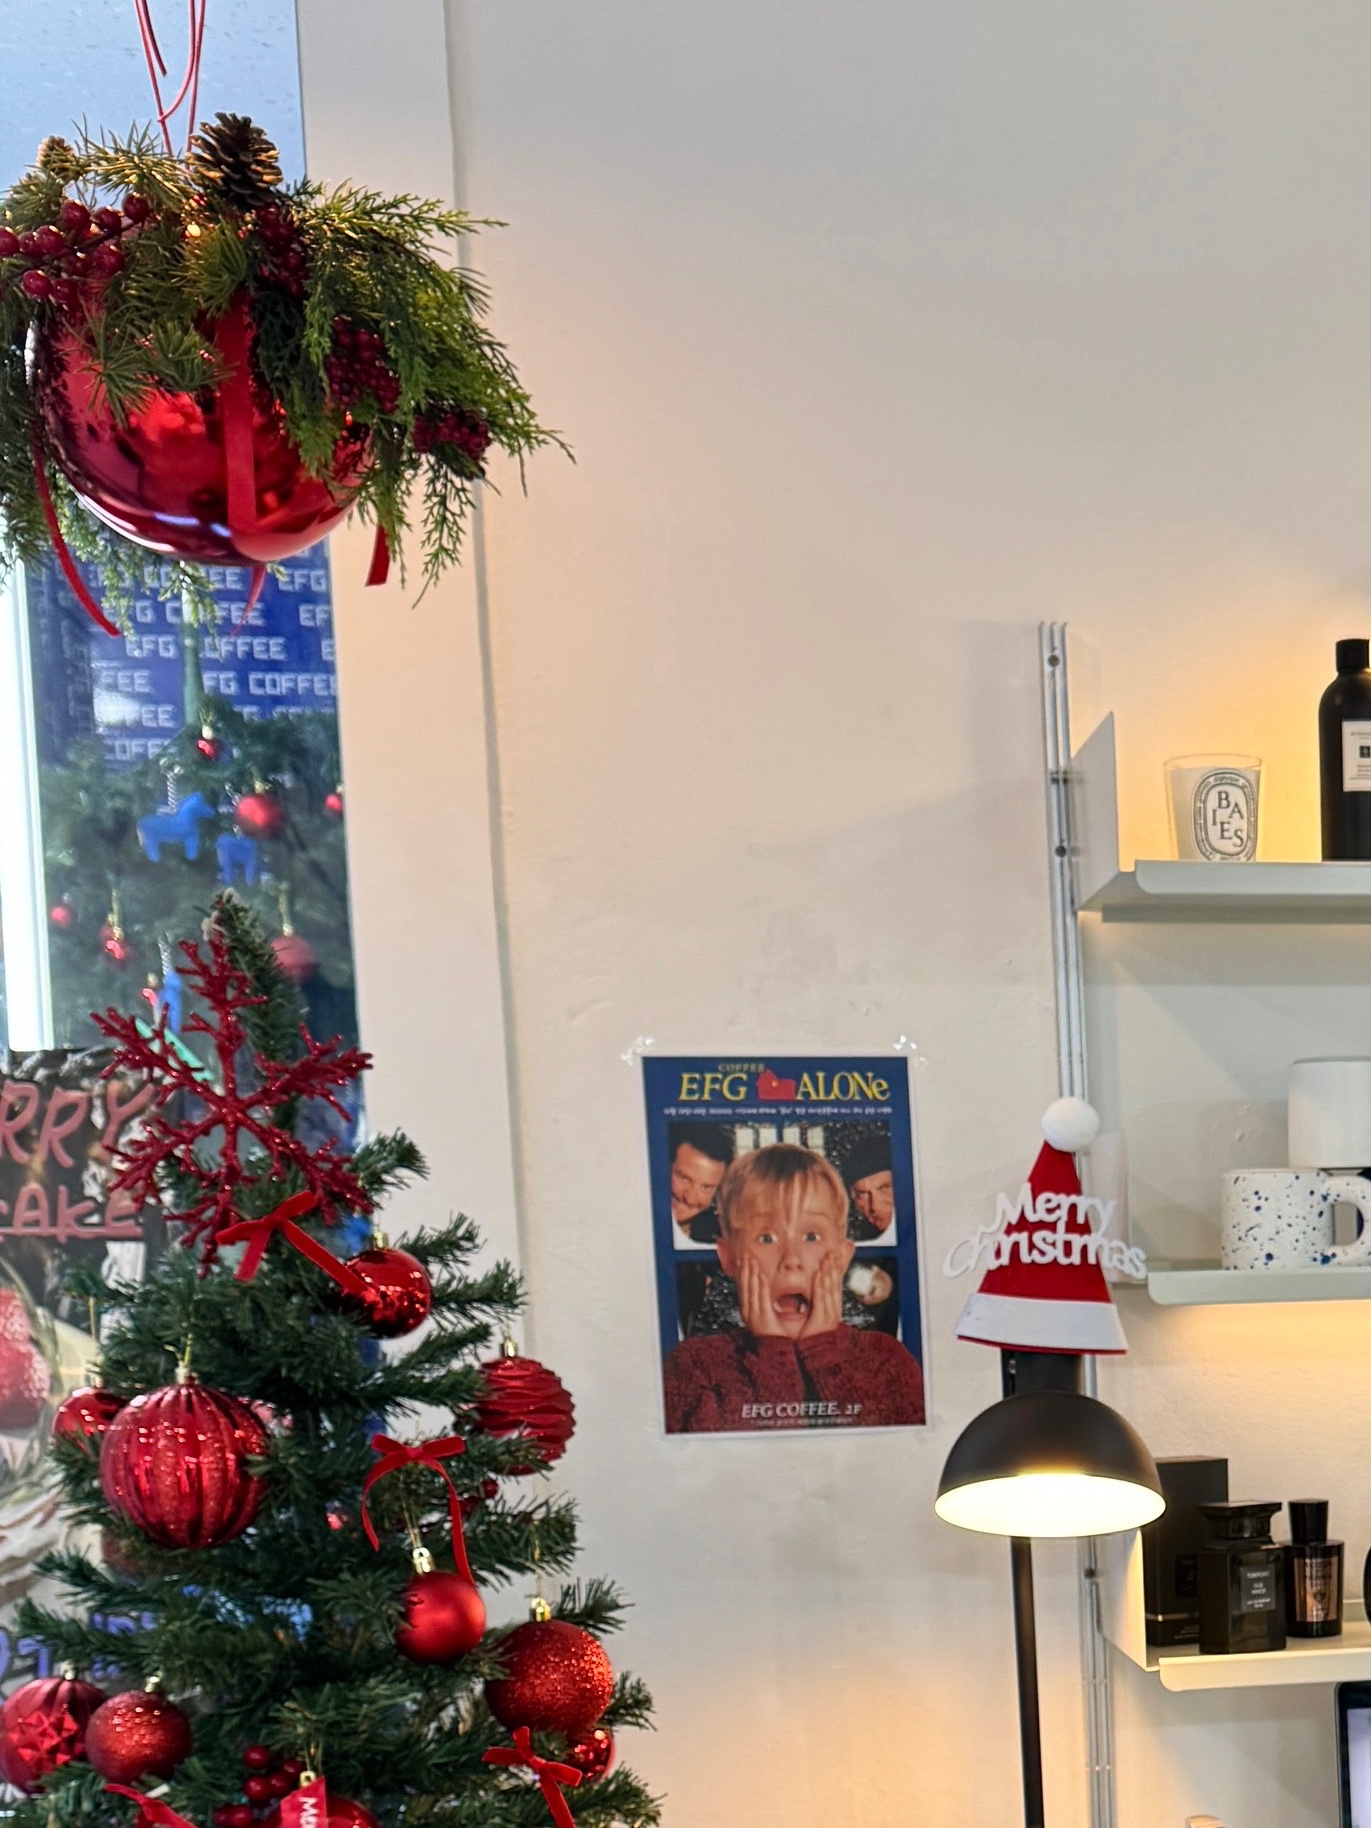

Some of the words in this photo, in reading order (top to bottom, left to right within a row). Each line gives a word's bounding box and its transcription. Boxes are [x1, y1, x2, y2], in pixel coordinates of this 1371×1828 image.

[278, 568, 327, 592] EFG
[125, 635, 177, 659] EFG
[200, 636, 287, 660] OFFEE
[202, 671, 238, 695] FG
[249, 672, 338, 697] COFFE
[678, 1072, 748, 1102] EFG
[0, 1181, 143, 1244] AKE
[985, 1181, 1118, 1238] Merry
[942, 1217, 1148, 1279] Christmas
[741, 1403, 773, 1418] EFG
